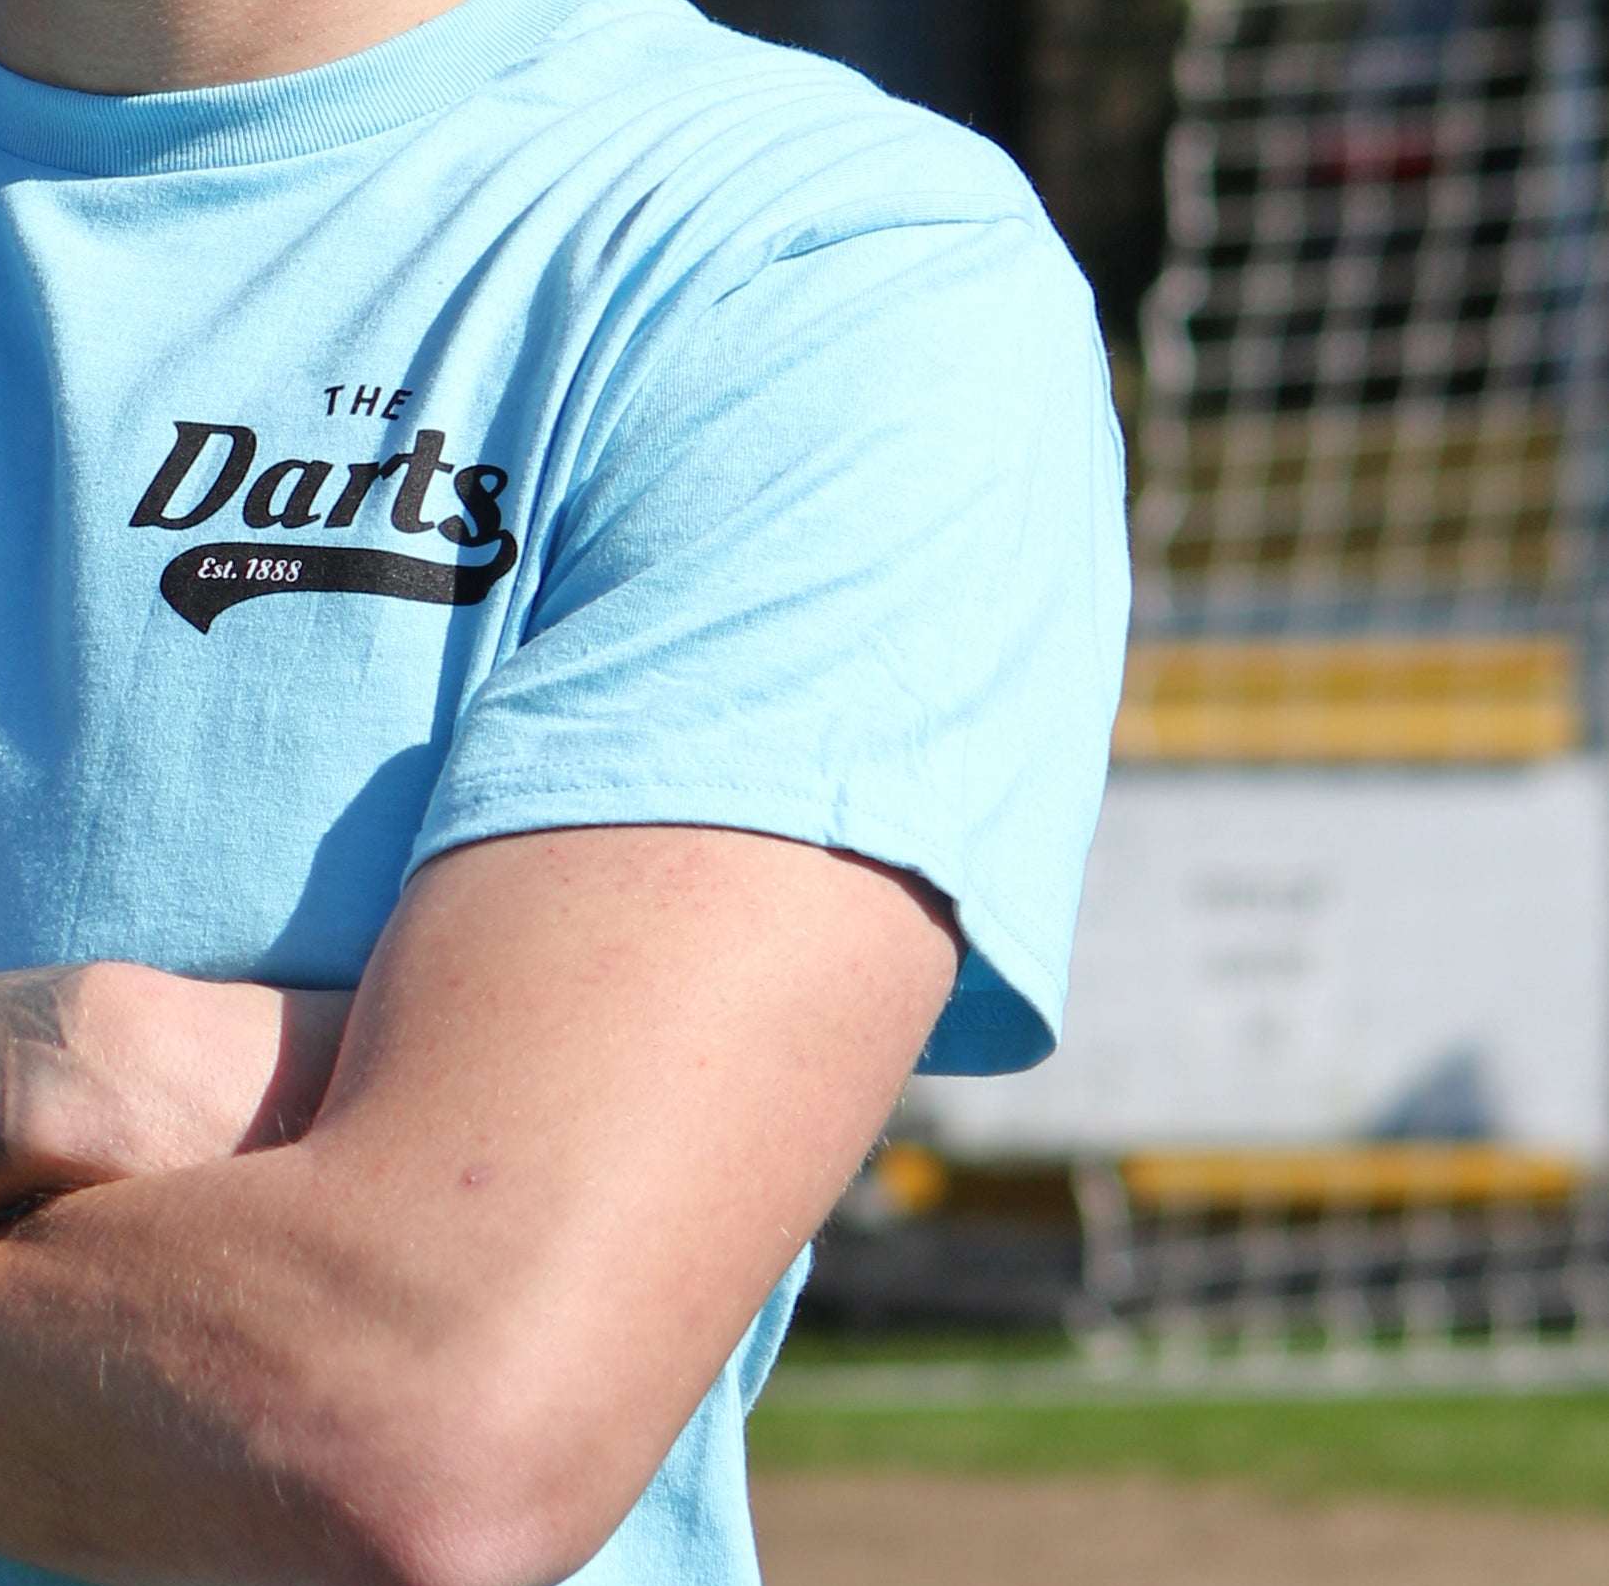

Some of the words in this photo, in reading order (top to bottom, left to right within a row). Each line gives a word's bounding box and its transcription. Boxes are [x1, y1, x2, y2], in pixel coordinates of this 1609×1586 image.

[324, 384, 413, 421] THE
[128, 420, 518, 548] Darts
[197, 557, 237, 581] Est.
[245, 557, 303, 583] 1888
